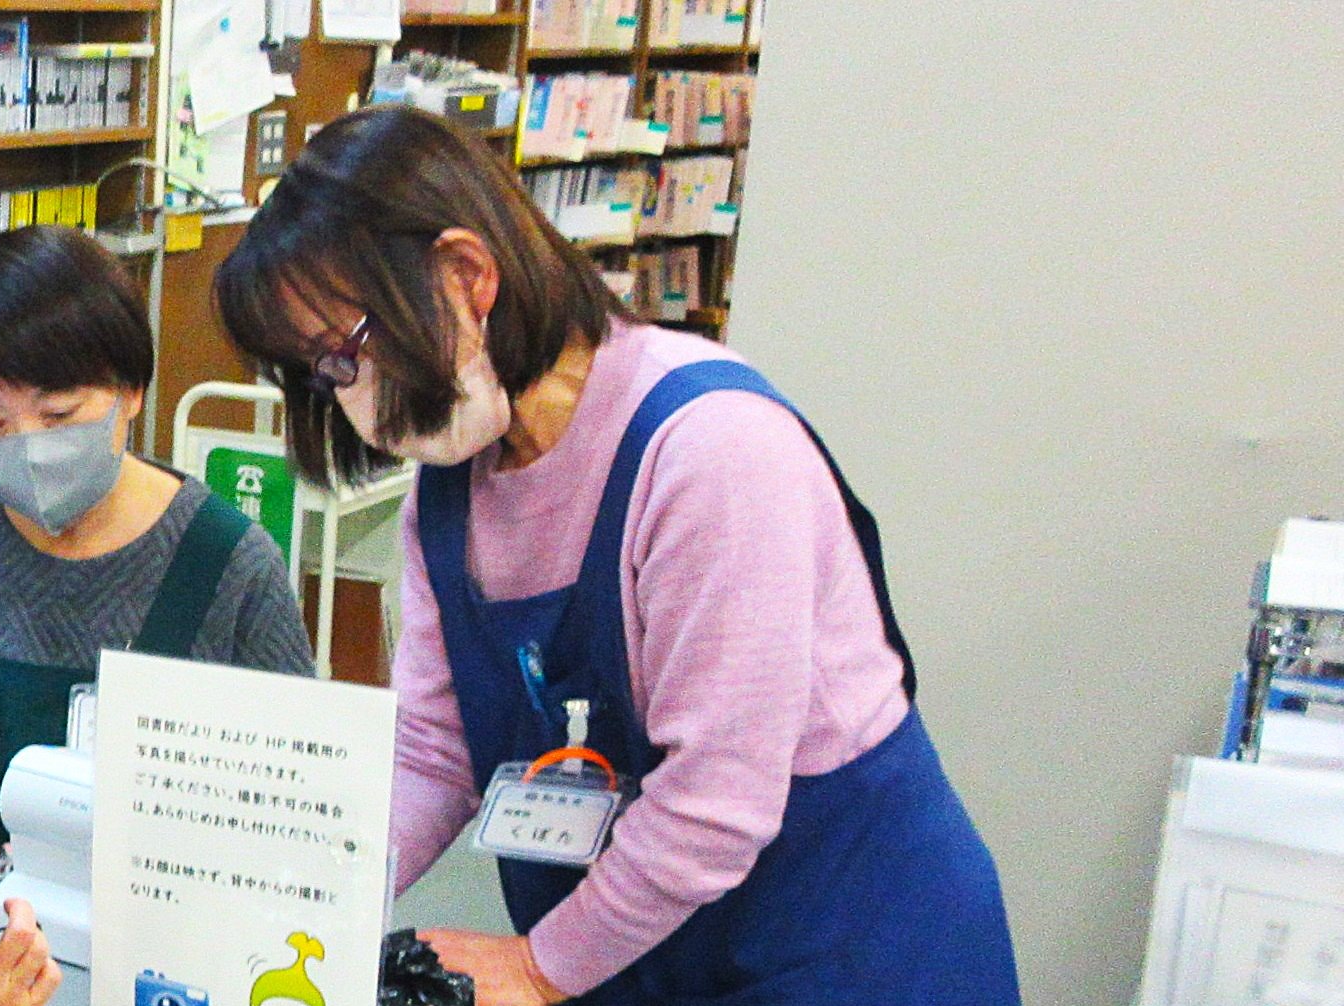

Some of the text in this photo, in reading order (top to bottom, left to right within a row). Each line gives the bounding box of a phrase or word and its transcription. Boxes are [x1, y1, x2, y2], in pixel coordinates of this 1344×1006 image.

[136, 715, 348, 760] 図書館だより および HP 掲載用の
[130, 882, 180, 904] なります。
